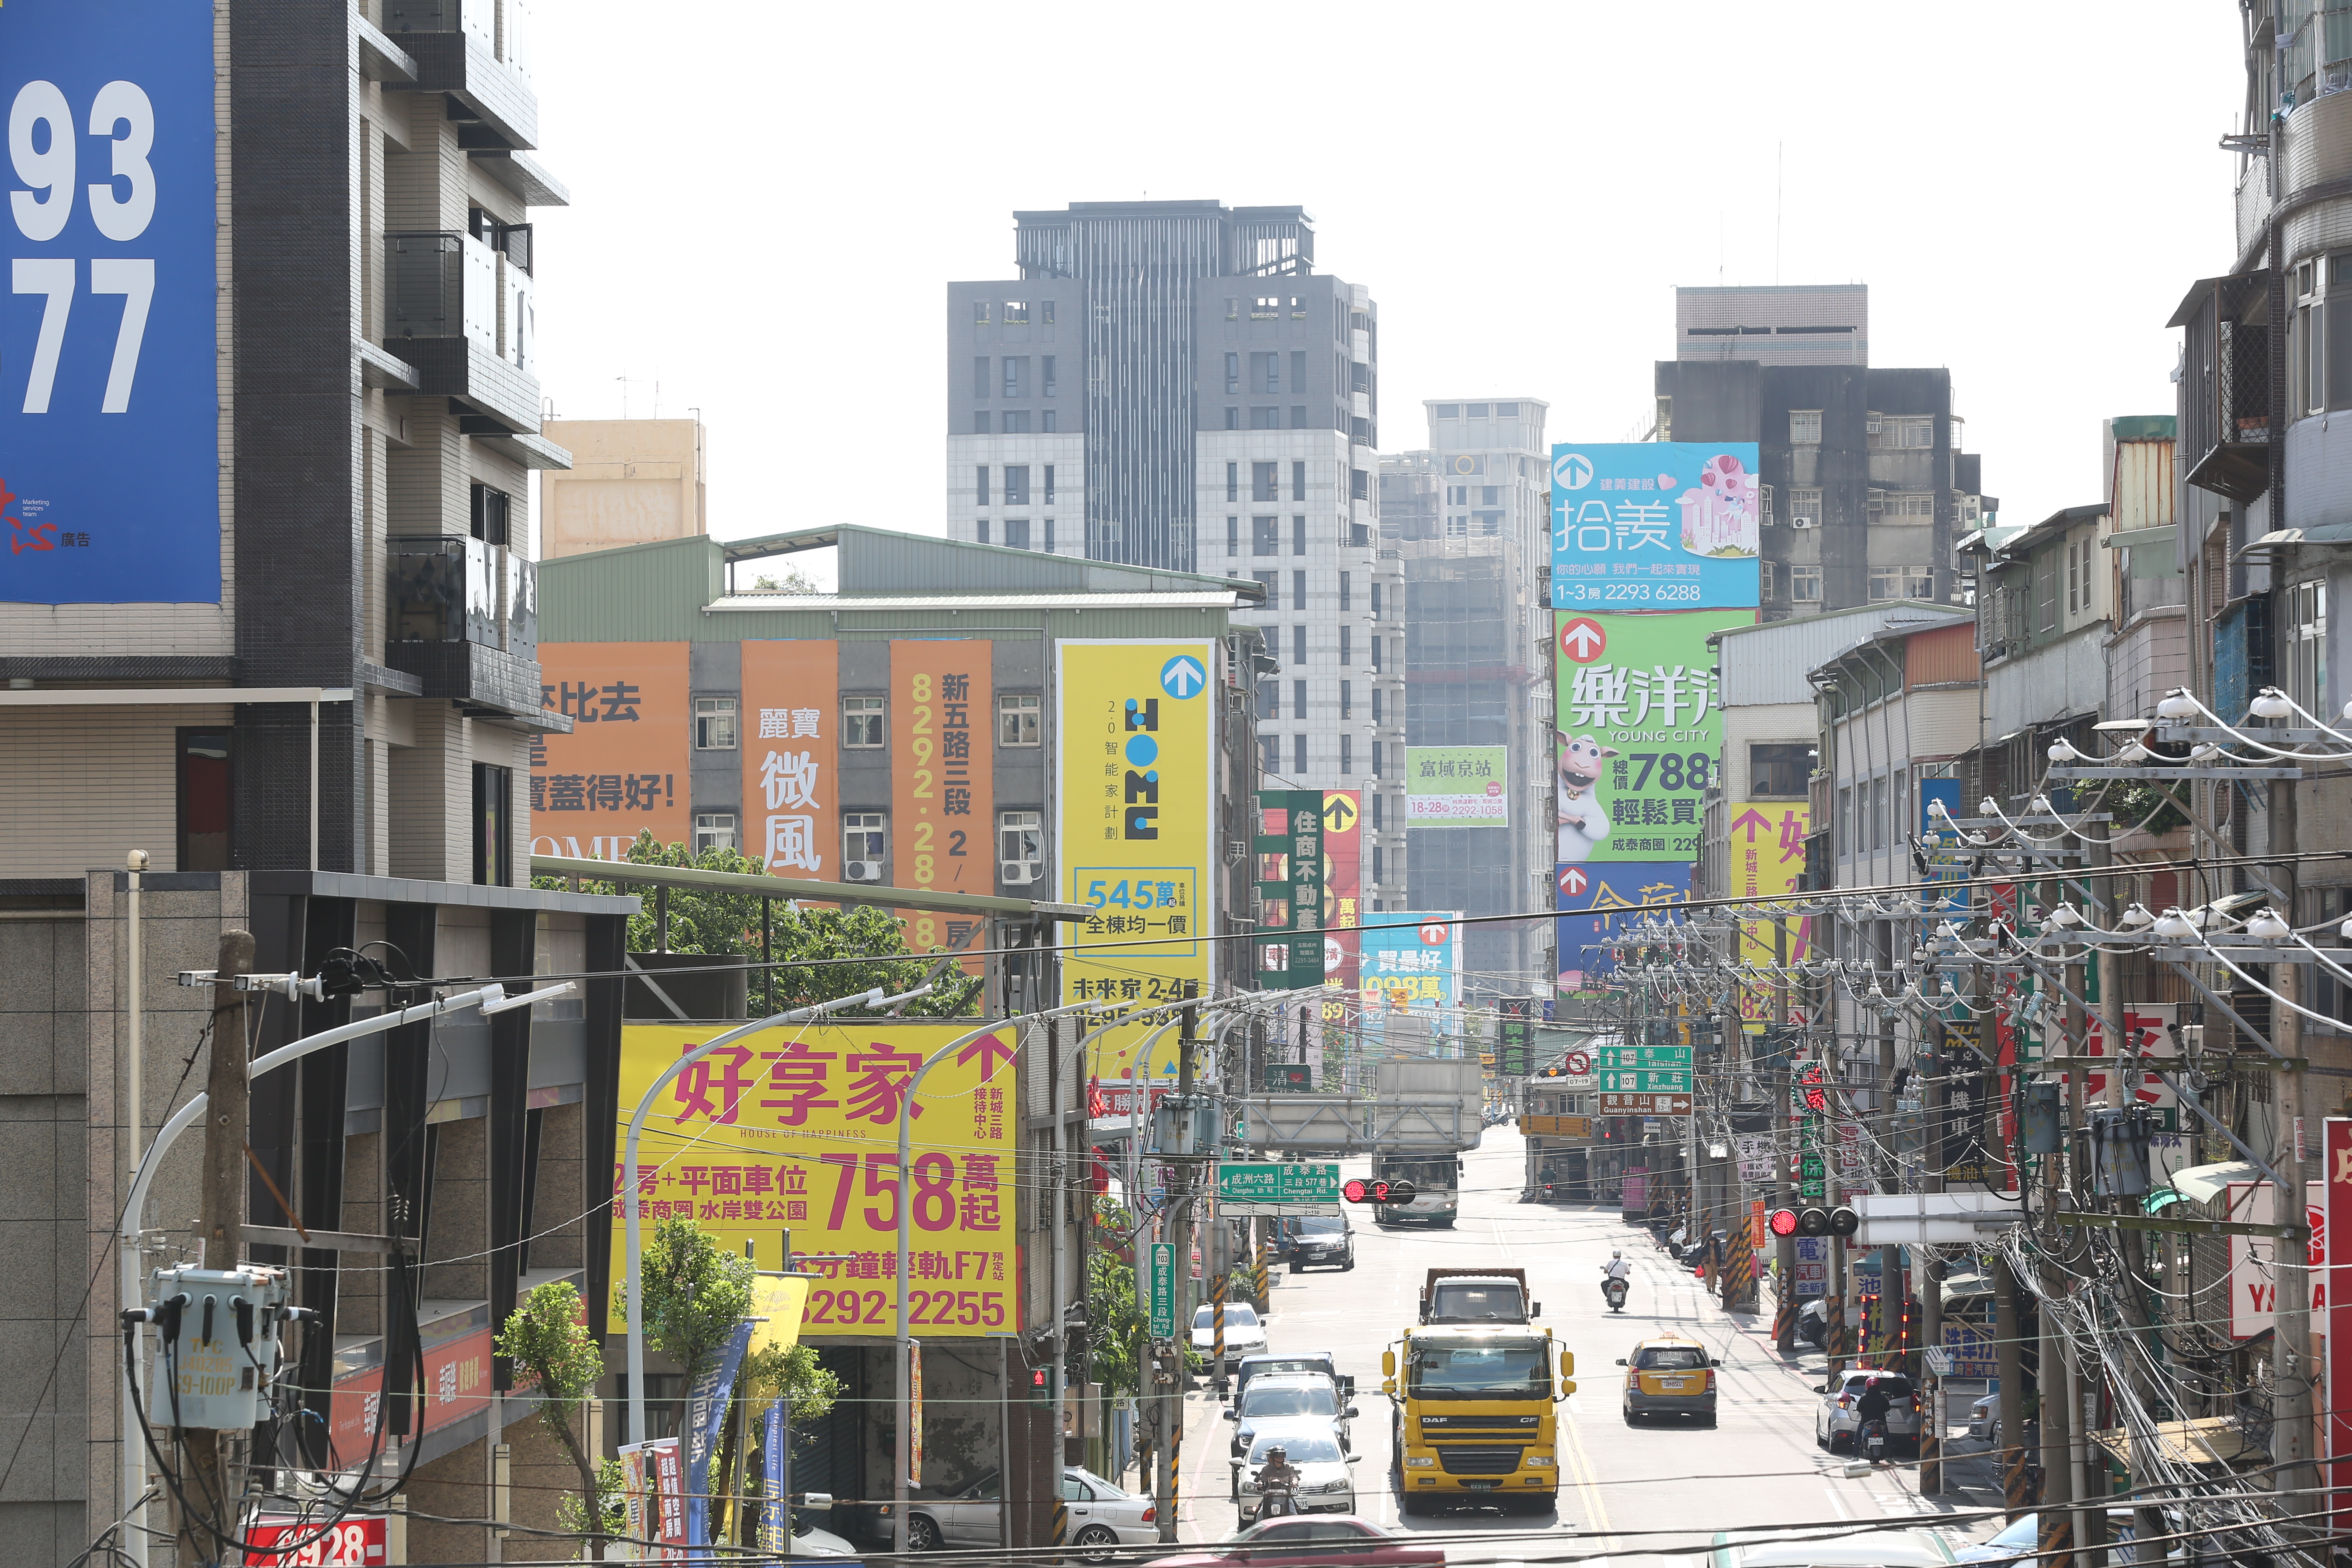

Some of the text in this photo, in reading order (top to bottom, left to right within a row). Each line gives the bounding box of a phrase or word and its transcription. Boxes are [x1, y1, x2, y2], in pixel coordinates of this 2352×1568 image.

[9, 80, 156, 242] 93
[12, 258, 156, 413] 77
[1600, 478, 1655, 491] 建義建設
[61, 532, 91, 548] 廣告
[1556, 563, 1701, 576] 你的心願 我們一起來實現
[1557, 584, 1701, 601] 1~3房 2293 6288
[758, 707, 821, 739] 麗寶
[942, 673, 971, 816] 新五路三段
[1608, 730, 1710, 742] YOUNG CITY
[1420, 760, 1491, 777] 富域京站
[1613, 760, 1628, 791] 總價
[1629, 752, 1720, 791] 788
[1411, 802, 1442, 813] 18-28
[1452, 806, 1503, 815] 2292-1058
[1612, 798, 1704, 826] 輕鬆買
[1612, 838, 1666, 851] 成泰商圈
[1294, 810, 1318, 930] 住商不動產
[1746, 848, 1759, 950] 新城三路中心
[1085, 915, 1187, 935] 全棟均一價
[1072, 978, 1142, 1000] 未來家
[1622, 1048, 1686, 1062] 107 泰山
[674, 1041, 925, 1126] 好享家
[1622, 1072, 1683, 1085] 107 新莊
[1647, 1083, 1683, 1091] Xinzhuang
[1607, 1095, 1650, 1106] 觀音山
[973, 1087, 987, 1140] 接待中心
[989, 1087, 1003, 1140] 新城三路
[740, 1129, 866, 1138] HOUSE OF HAPPINESS
[1232, 1173, 1275, 1185] 成洲六路
[1283, 1165, 1327, 1176] 成泰路
[820, 1152, 1001, 1232] 758 萬起
[699, 1200, 807, 1221] 水岸雙公園
[992, 1252, 1004, 1281] 預定站
[1157, 1255, 1167, 1263] 103
[1797, 1265, 1826, 1279] 汽車
[1157, 1266, 1168, 1317] 成泰路三段
[1945, 1327, 1998, 1360] 洗車打
[364, 1390, 383, 1438] 幸福
[771, 1412, 780, 1451] Happiest
[668, 1457, 682, 1537] 超值空間
